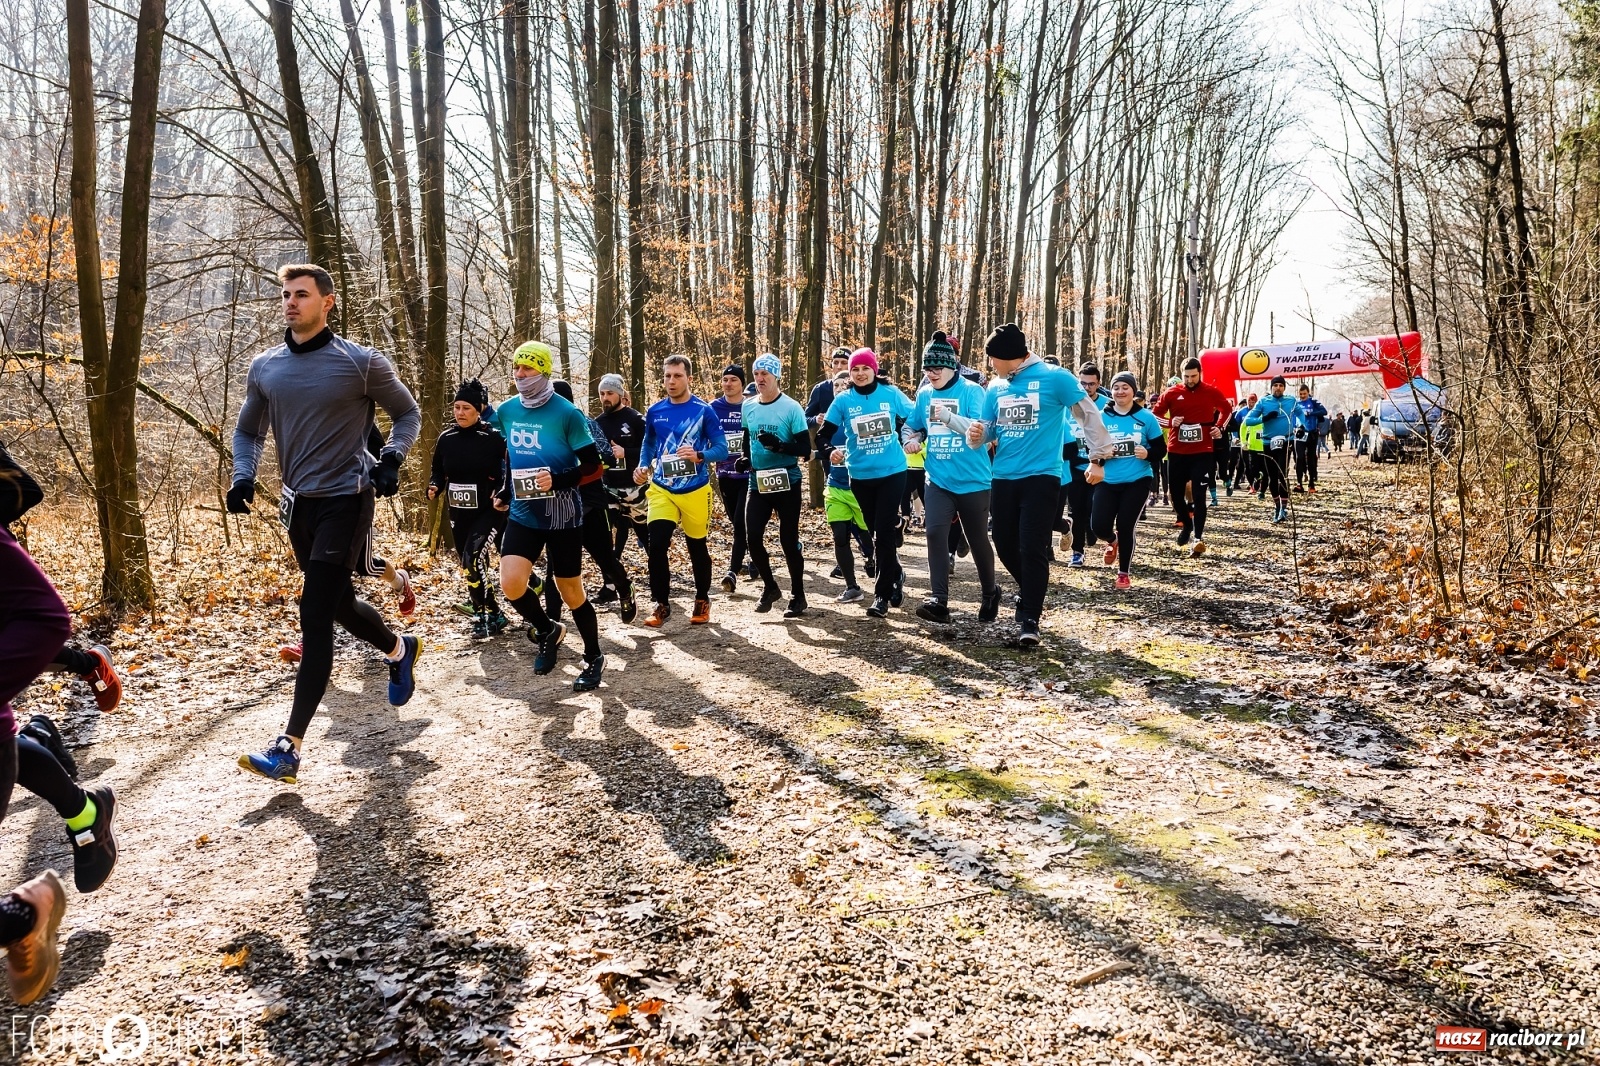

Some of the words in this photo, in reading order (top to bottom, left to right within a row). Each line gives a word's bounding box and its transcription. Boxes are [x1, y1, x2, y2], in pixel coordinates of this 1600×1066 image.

[1295, 344, 1321, 352] BIEG
[518, 353, 536, 362] XYZ
[1276, 352, 1341, 364] TWARDZIELA
[1283, 363, 1335, 374] RACIBÓRZ
[1005, 407, 1026, 418] 005
[864, 420, 884, 432] 134
[510, 428, 542, 450] bbl
[930, 437, 963, 447] BIEG
[670, 460, 687, 471] 115
[762, 476, 783, 487] 006
[452, 491, 471, 502] 080
